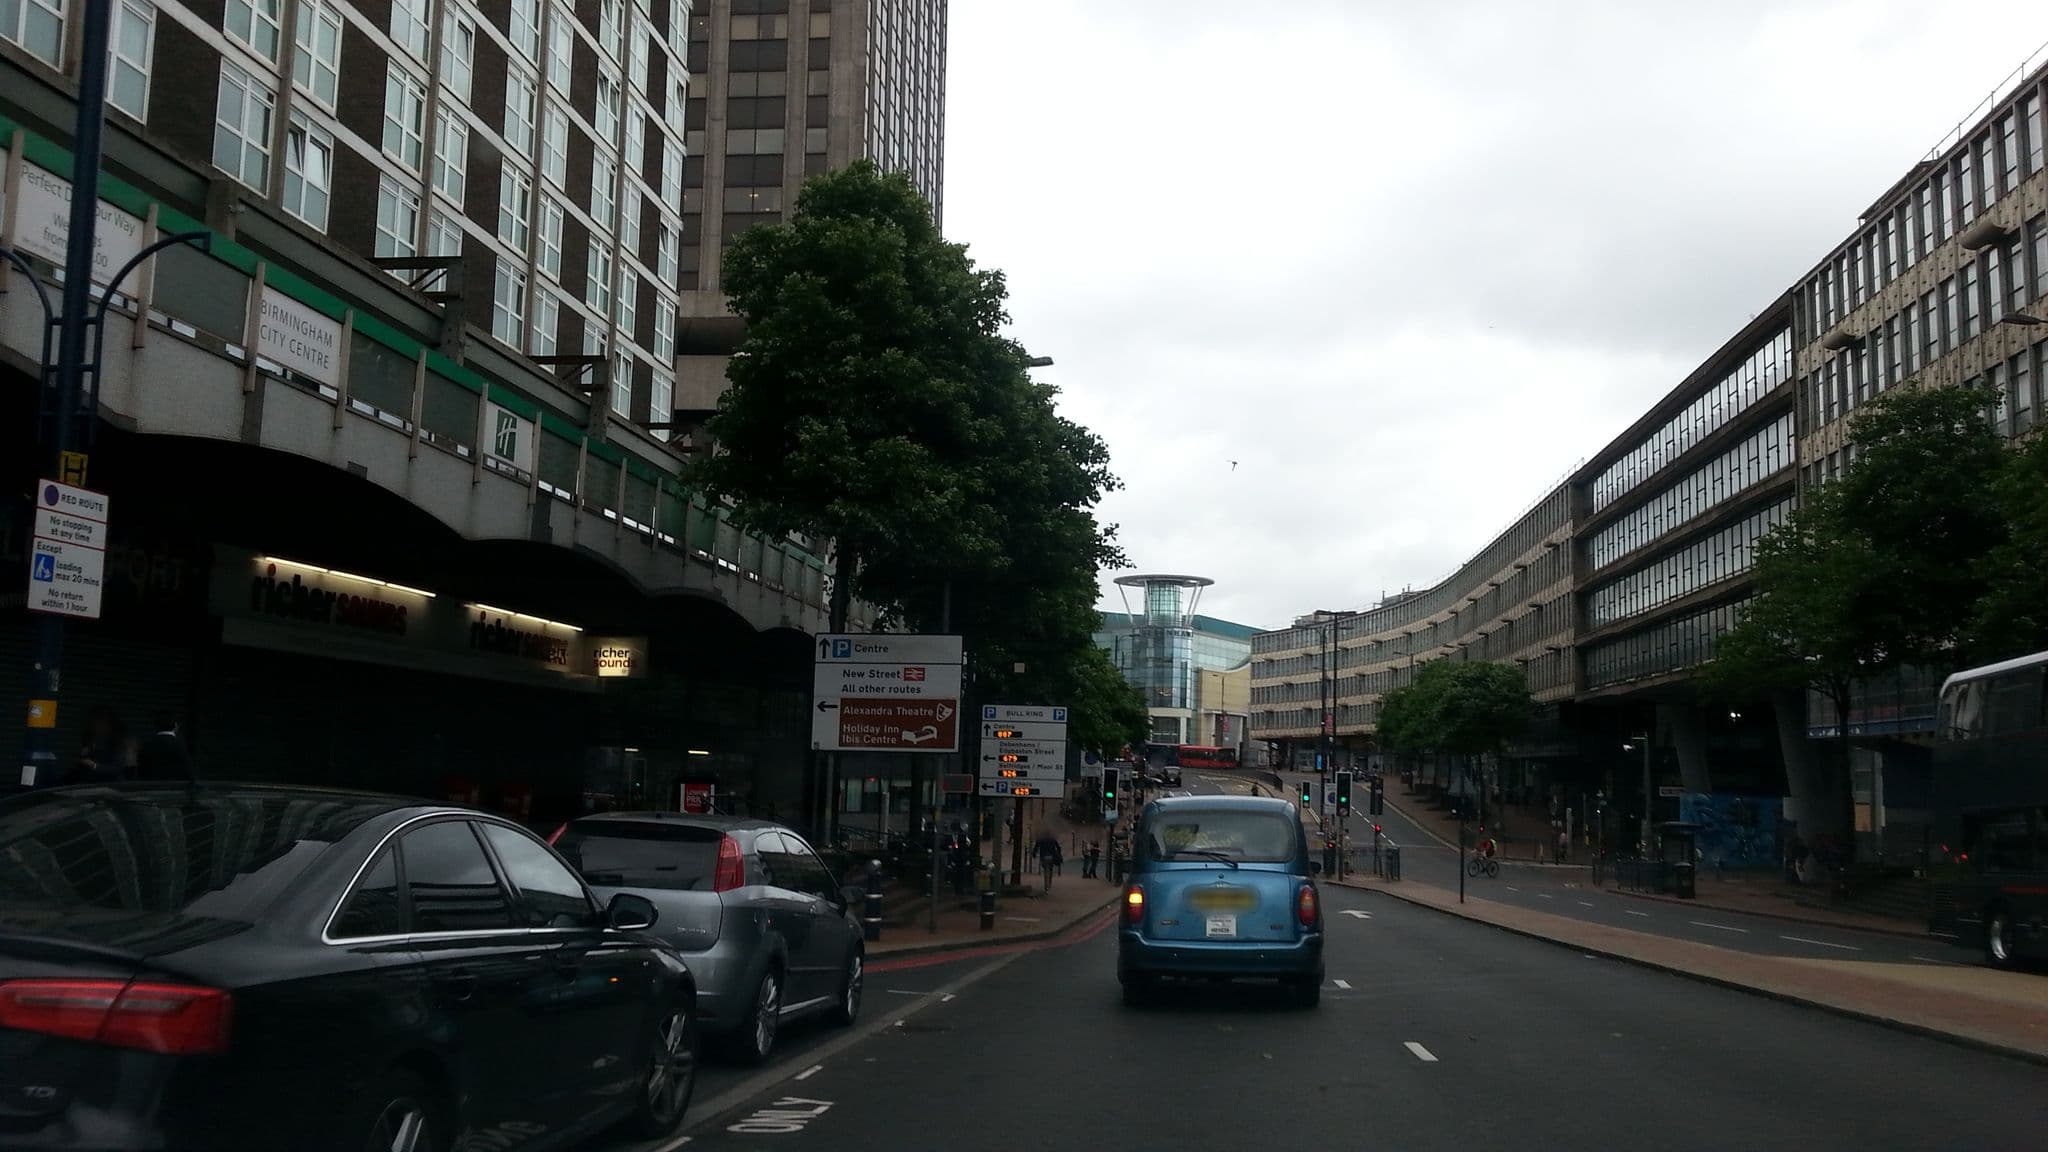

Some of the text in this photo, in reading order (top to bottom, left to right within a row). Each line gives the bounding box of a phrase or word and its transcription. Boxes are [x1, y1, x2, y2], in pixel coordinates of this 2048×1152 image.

[22, 164, 62, 198] Perfect
[115, 213, 136, 238] Way
[261, 299, 333, 348] BIRMINGHAM
[260, 325, 330, 370] CITY CENTRE
[60, 493, 104, 513] RED ROUTE
[50, 515, 93, 534] No stopping
[50, 527, 90, 543] at any time
[36, 541, 63, 555] Except
[56, 559, 83, 575] loading
[55, 573, 100, 588] max 20 mins
[48, 587, 84, 602] No return
[41, 598, 65, 610] within
[71, 601, 89, 613] hour
[593, 647, 631, 658] richer
[854, 643, 889, 654] Centre
[842, 668, 901, 679] New Street
[841, 684, 922, 695] All other routes
[843, 706, 935, 717] Alexandra Theatre
[842, 723, 900, 735] Holiday Inn
[841, 735, 898, 745] Ibis Centre
[725, 1096, 835, 1134] ONLY
